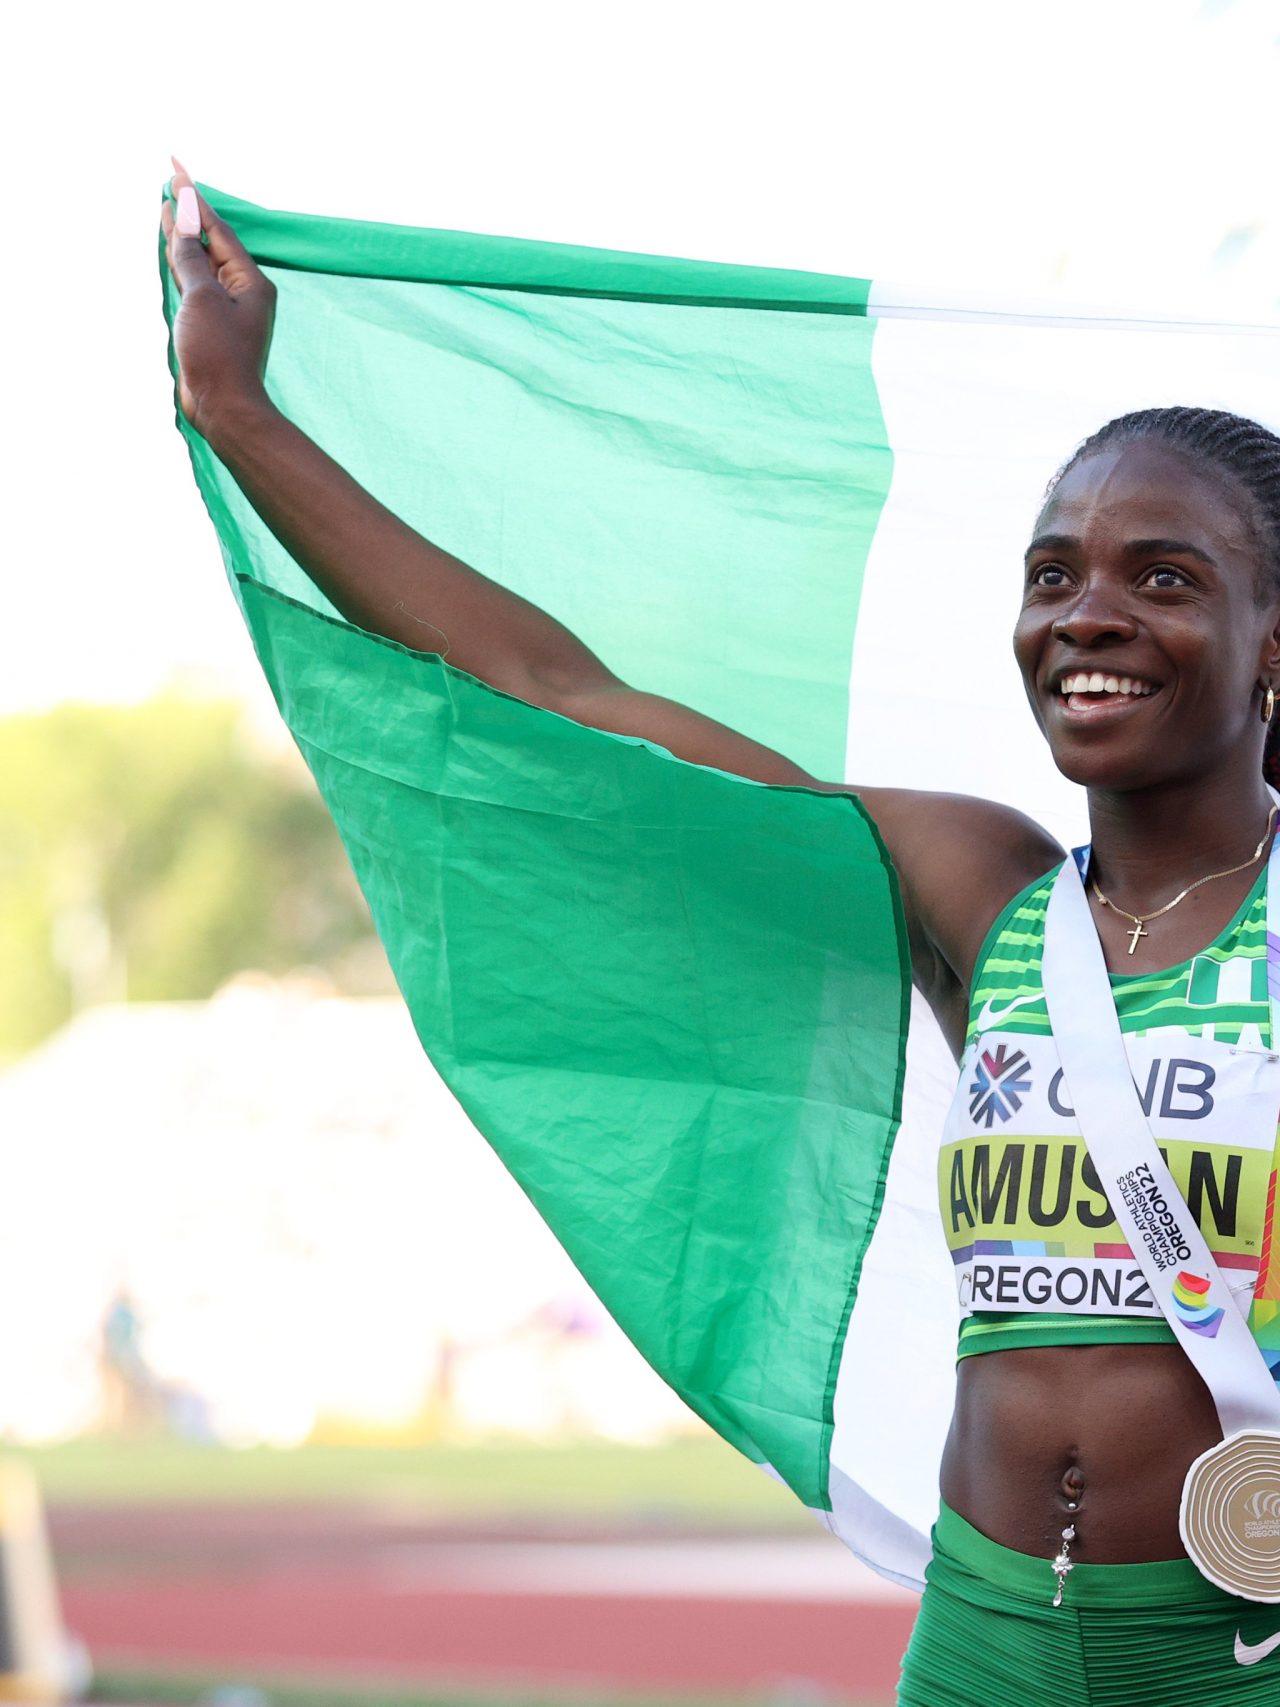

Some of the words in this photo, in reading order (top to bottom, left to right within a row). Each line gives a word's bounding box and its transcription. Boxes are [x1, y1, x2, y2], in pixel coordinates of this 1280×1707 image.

[950, 1143, 1243, 1238] AMUSN
[1116, 1176, 1148, 1231] ATHLETICS
[1125, 1170, 1178, 1266] CHAMPIONSHIPS
[1143, 1232, 1168, 1273] WORLD
